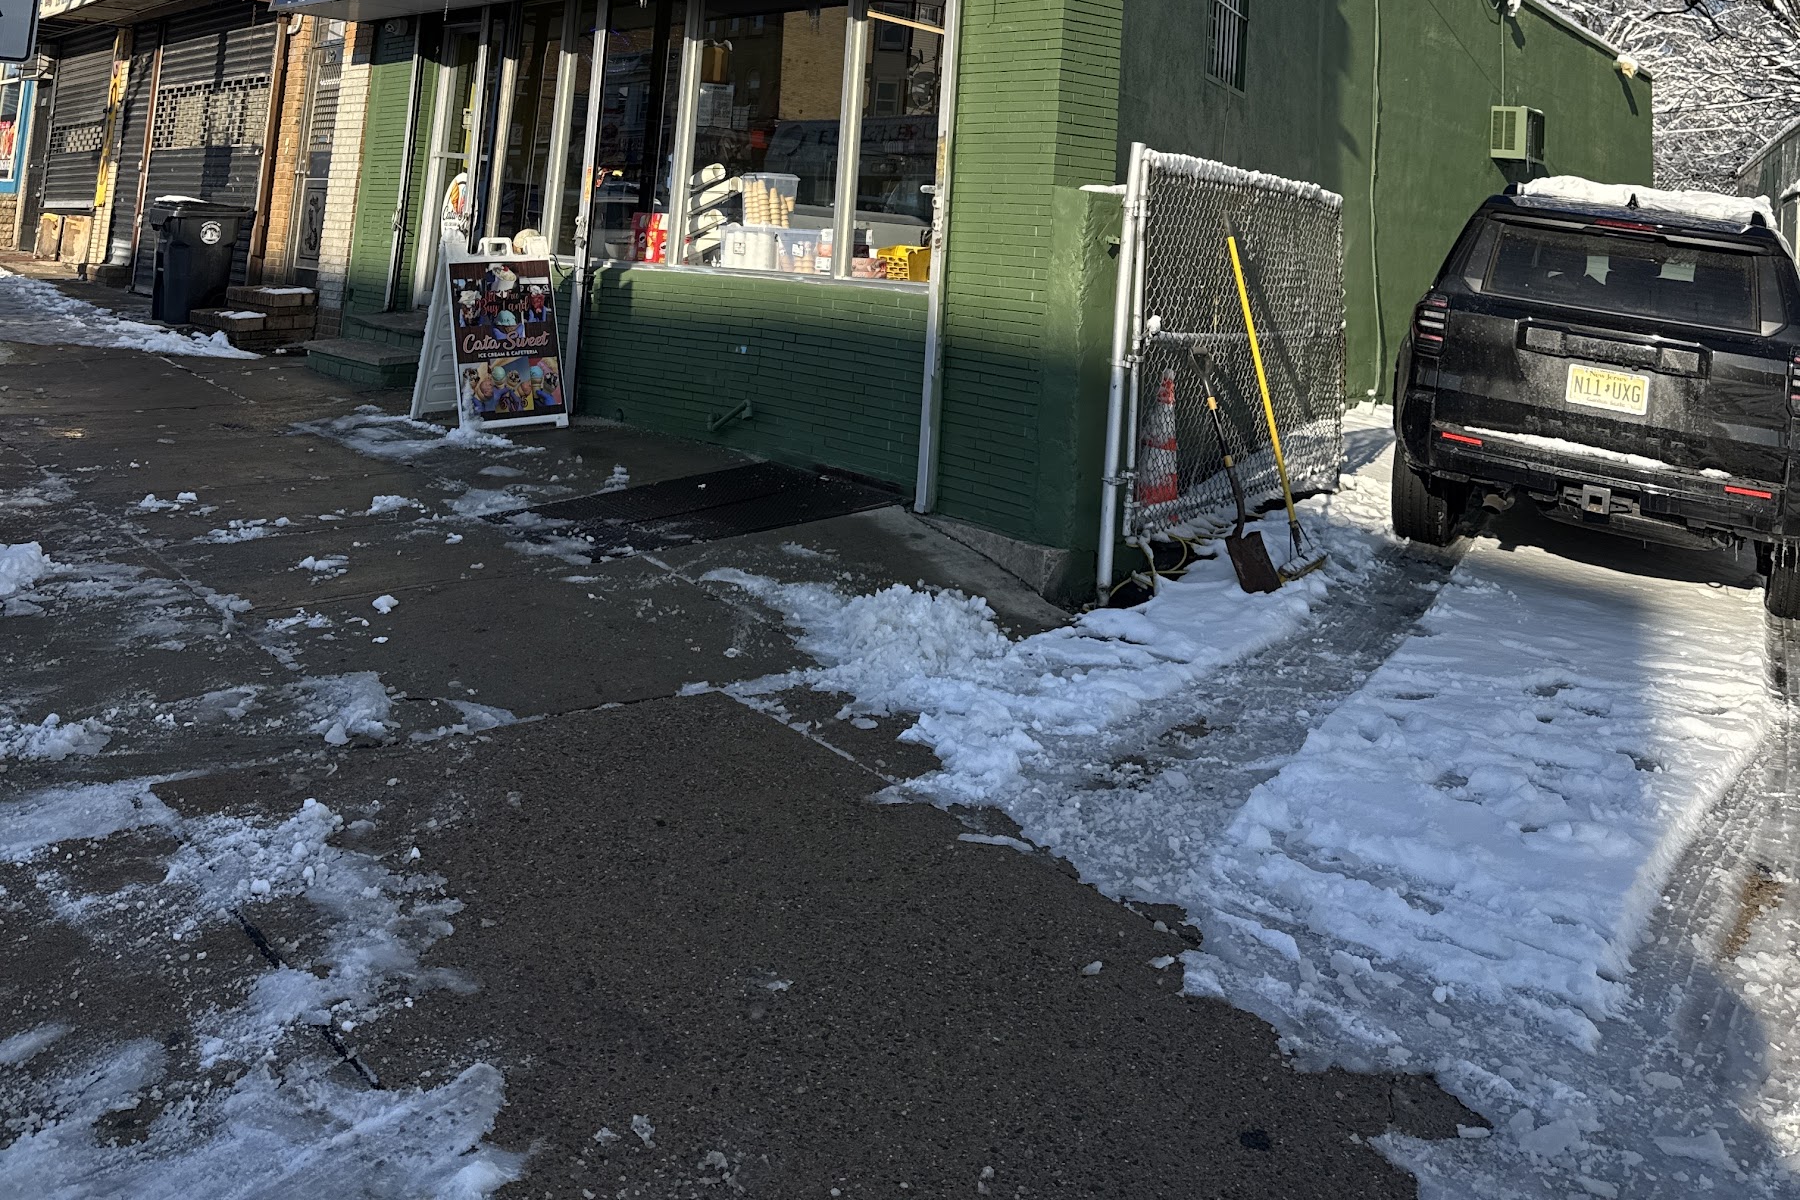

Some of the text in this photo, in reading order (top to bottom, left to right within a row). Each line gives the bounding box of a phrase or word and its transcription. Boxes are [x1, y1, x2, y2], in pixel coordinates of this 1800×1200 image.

[463, 330, 550, 354] Cata Sweet
[488, 350, 505, 358] CREAM
[511, 348, 538, 357] CAFETERIA
[1589, 370, 1605, 379] New
[1606, 373, 1628, 382] Jersey
